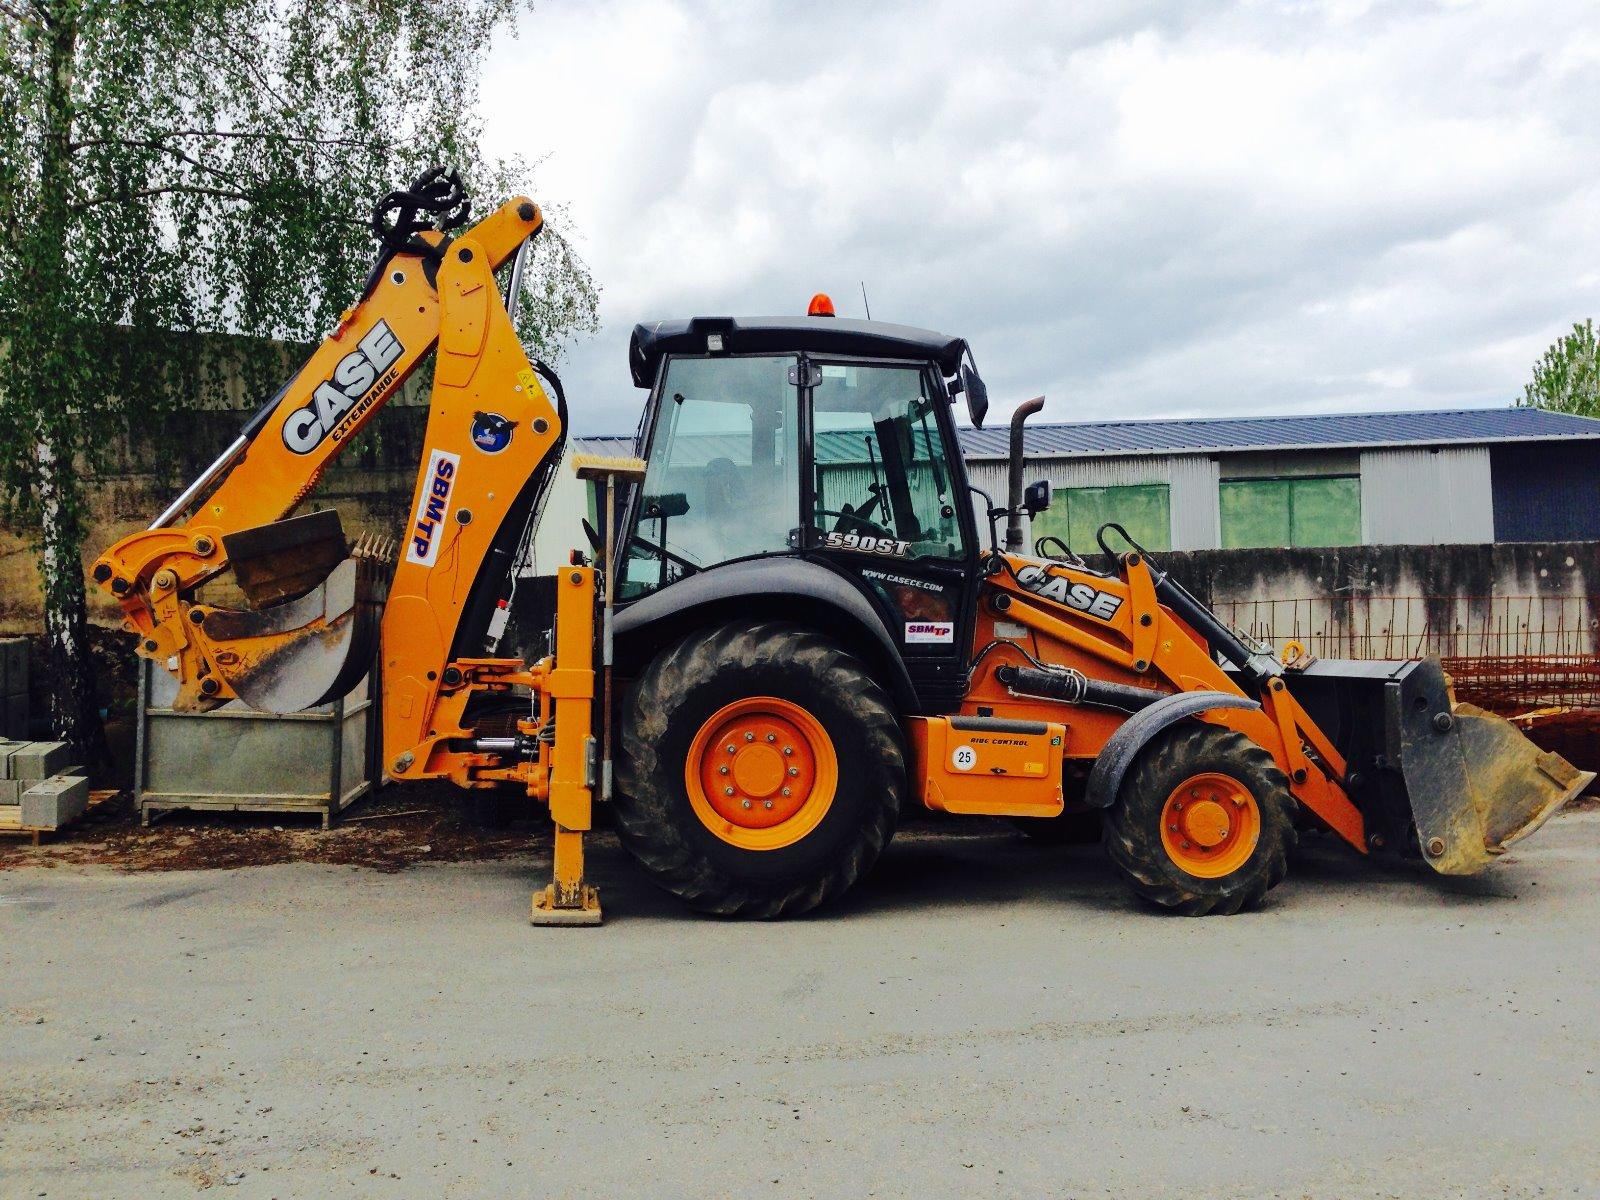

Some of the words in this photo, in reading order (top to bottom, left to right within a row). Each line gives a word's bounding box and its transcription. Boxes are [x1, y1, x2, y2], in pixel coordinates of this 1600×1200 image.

[282, 317, 405, 455] CASE
[825, 531, 912, 557] 590ST
[1016, 564, 1125, 622] CASE
[992, 738, 1029, 747] CONTROL
[958, 751, 971, 763] 25
